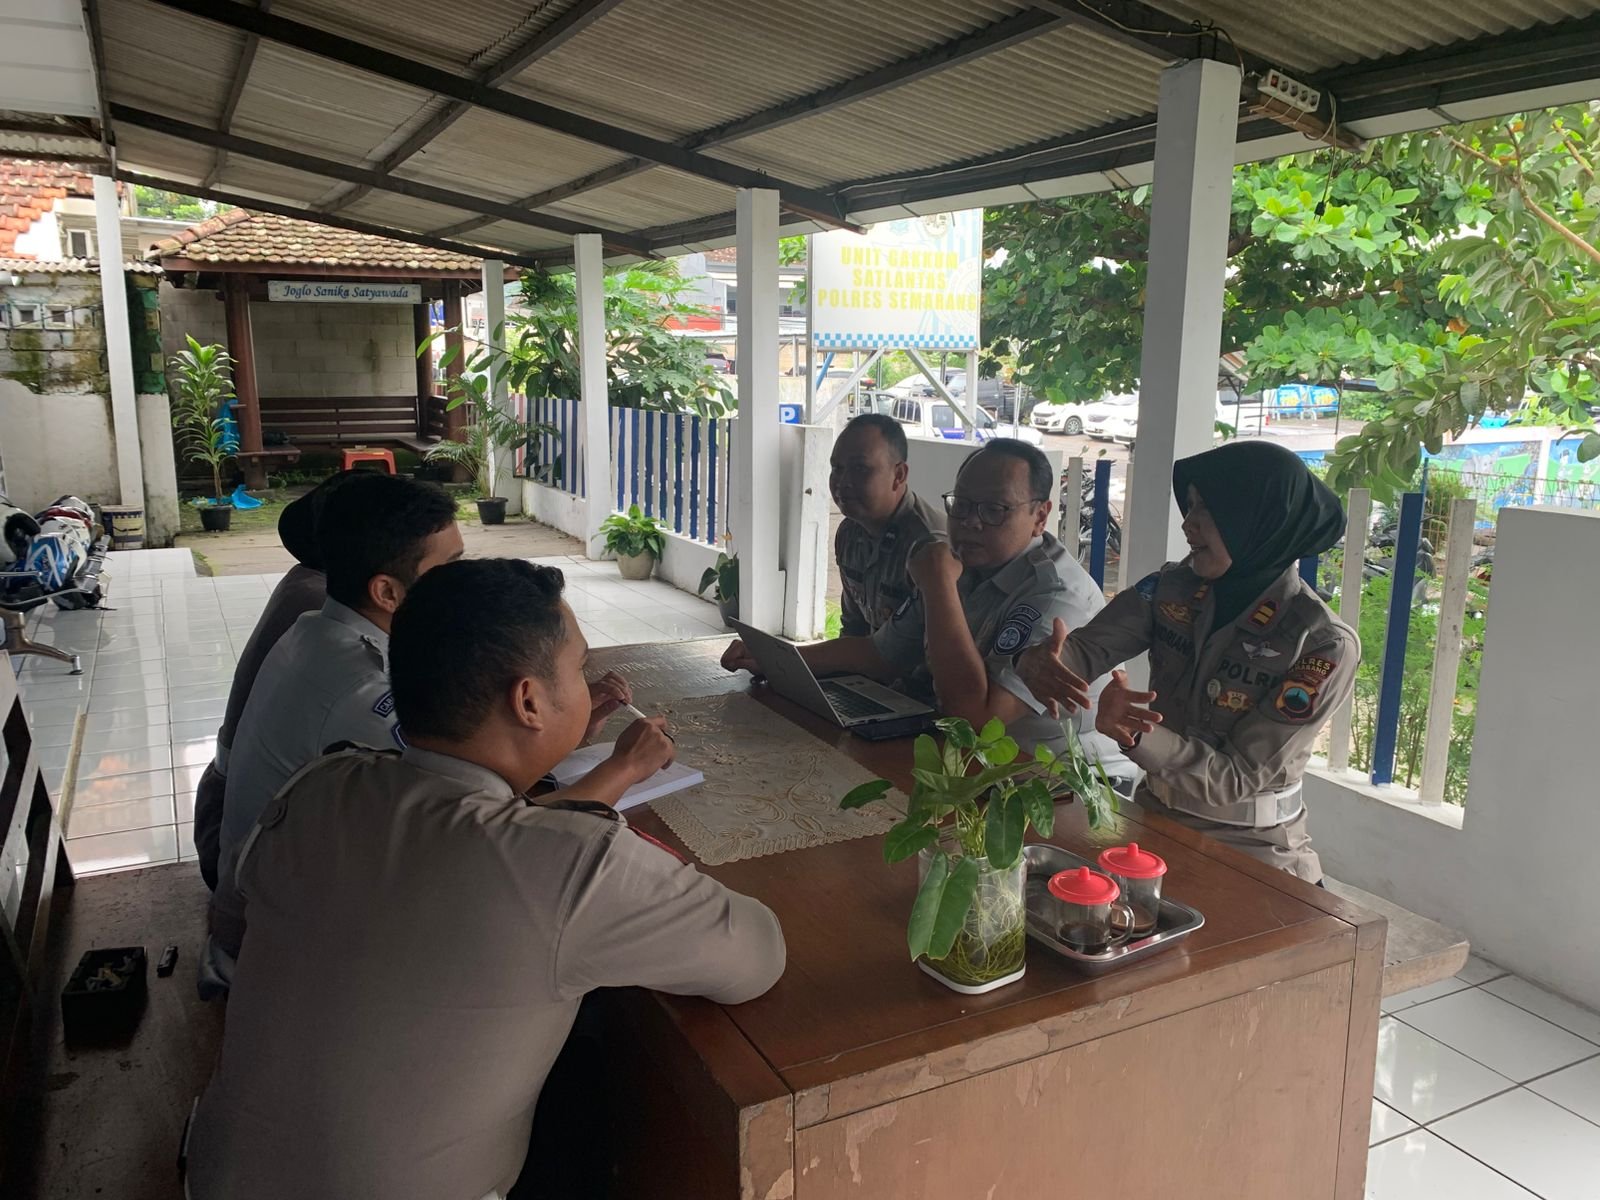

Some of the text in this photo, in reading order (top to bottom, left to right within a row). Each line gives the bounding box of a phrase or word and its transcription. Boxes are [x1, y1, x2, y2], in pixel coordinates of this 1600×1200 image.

[841, 246, 882, 267] UNIT
[852, 268, 946, 290] SATLANTAS
[283, 284, 409, 301] Joglo Sanika Satyawada
[817, 288, 976, 311] POLRES SEMARANG
[780, 407, 796, 424] P
[1216, 658, 1281, 689] POLRI
[1299, 657, 1331, 670] LRES
